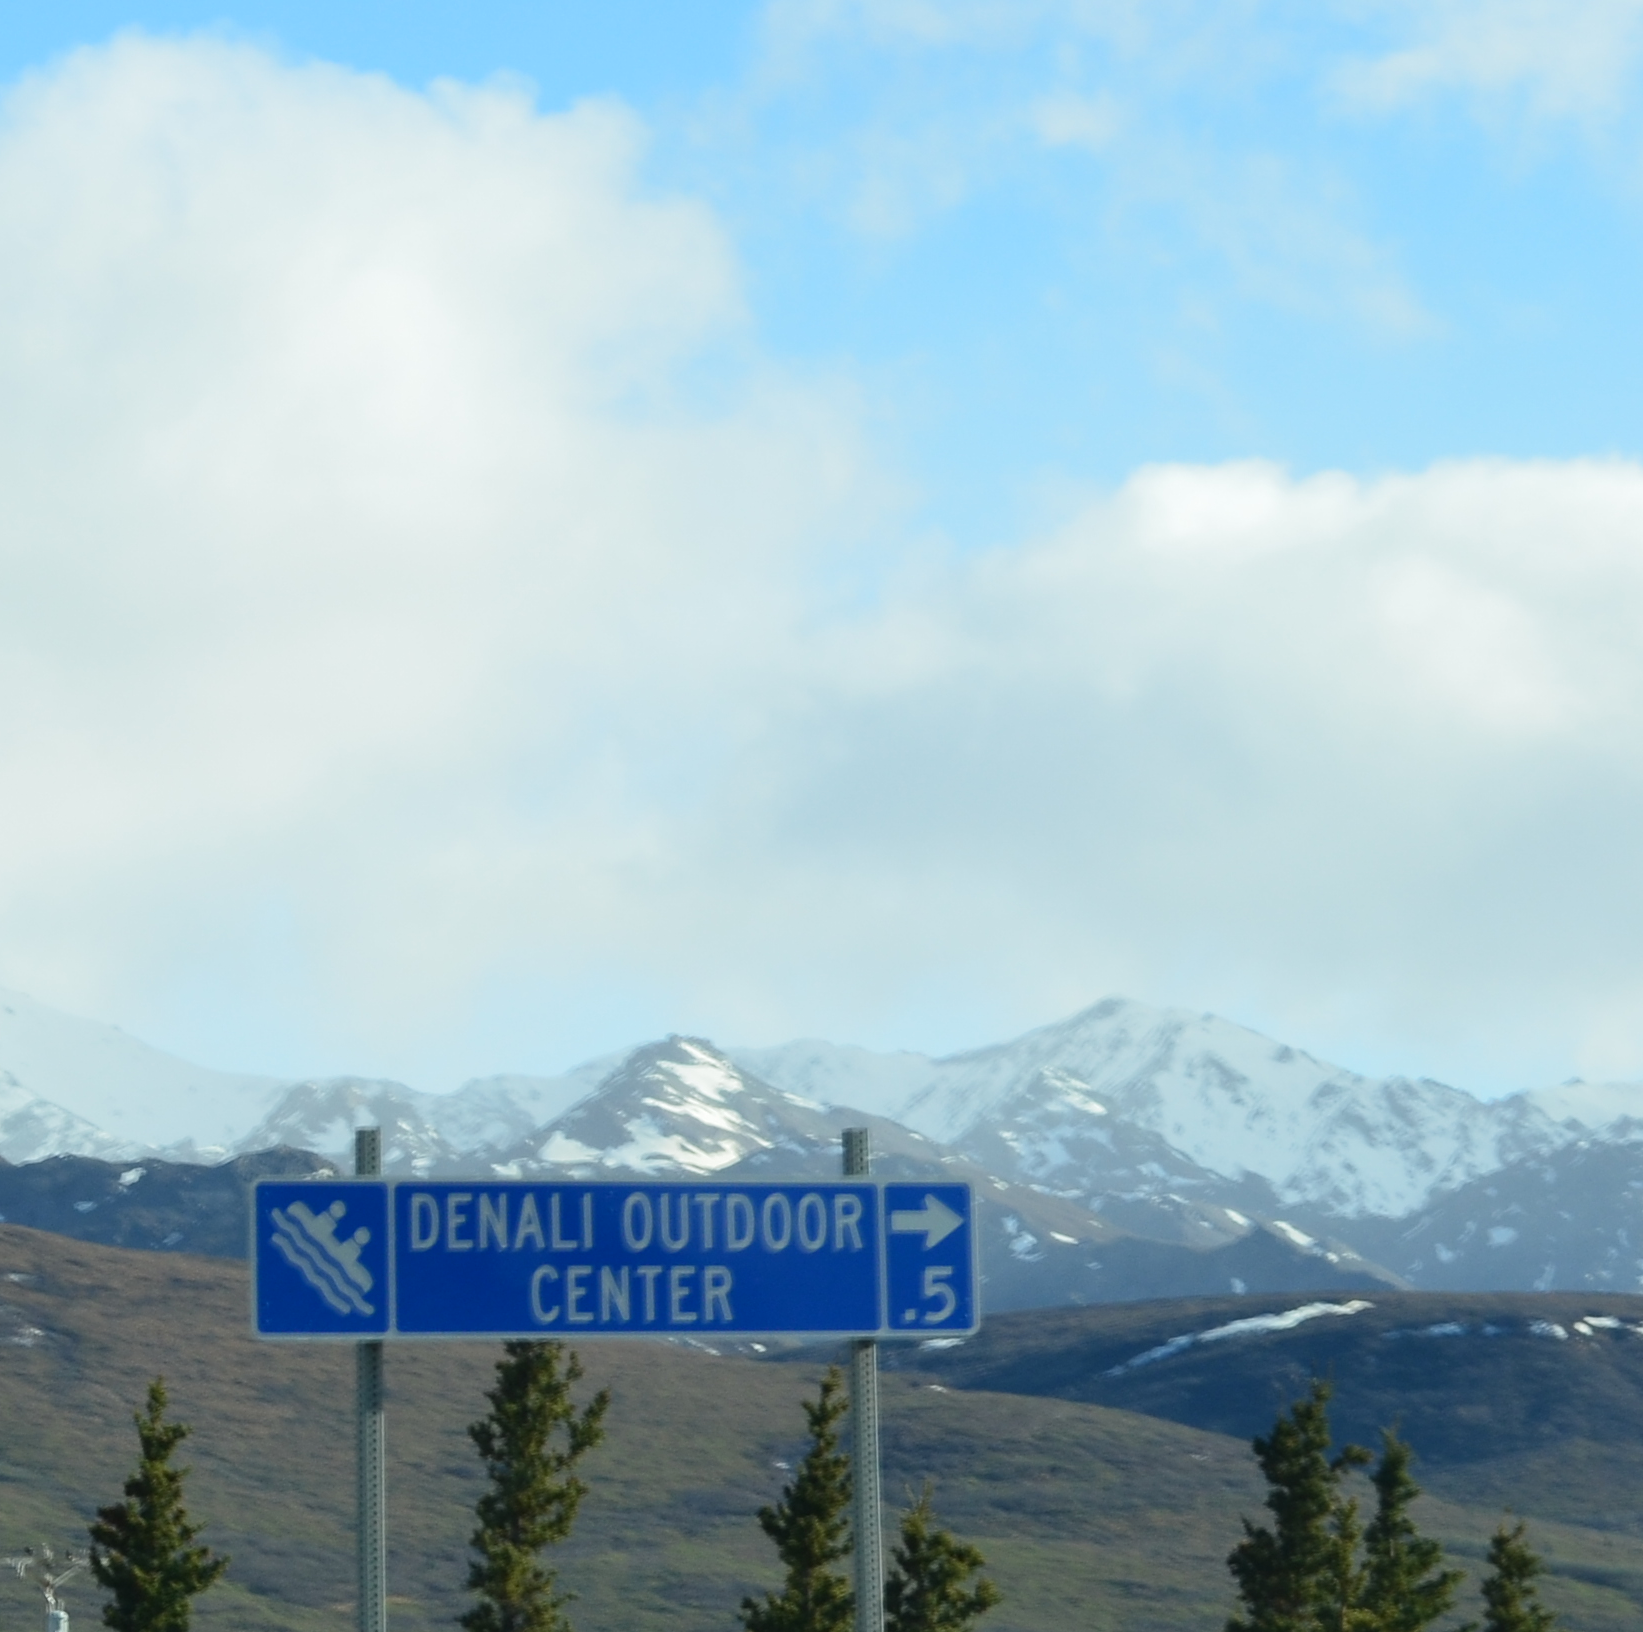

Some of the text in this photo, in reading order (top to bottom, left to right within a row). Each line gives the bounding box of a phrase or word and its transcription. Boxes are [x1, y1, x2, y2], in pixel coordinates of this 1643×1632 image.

[410, 1191, 863, 1251] DENALI OUTDOOR
[530, 1265, 734, 1324] CENTER
[901, 1266, 958, 1323] .5
